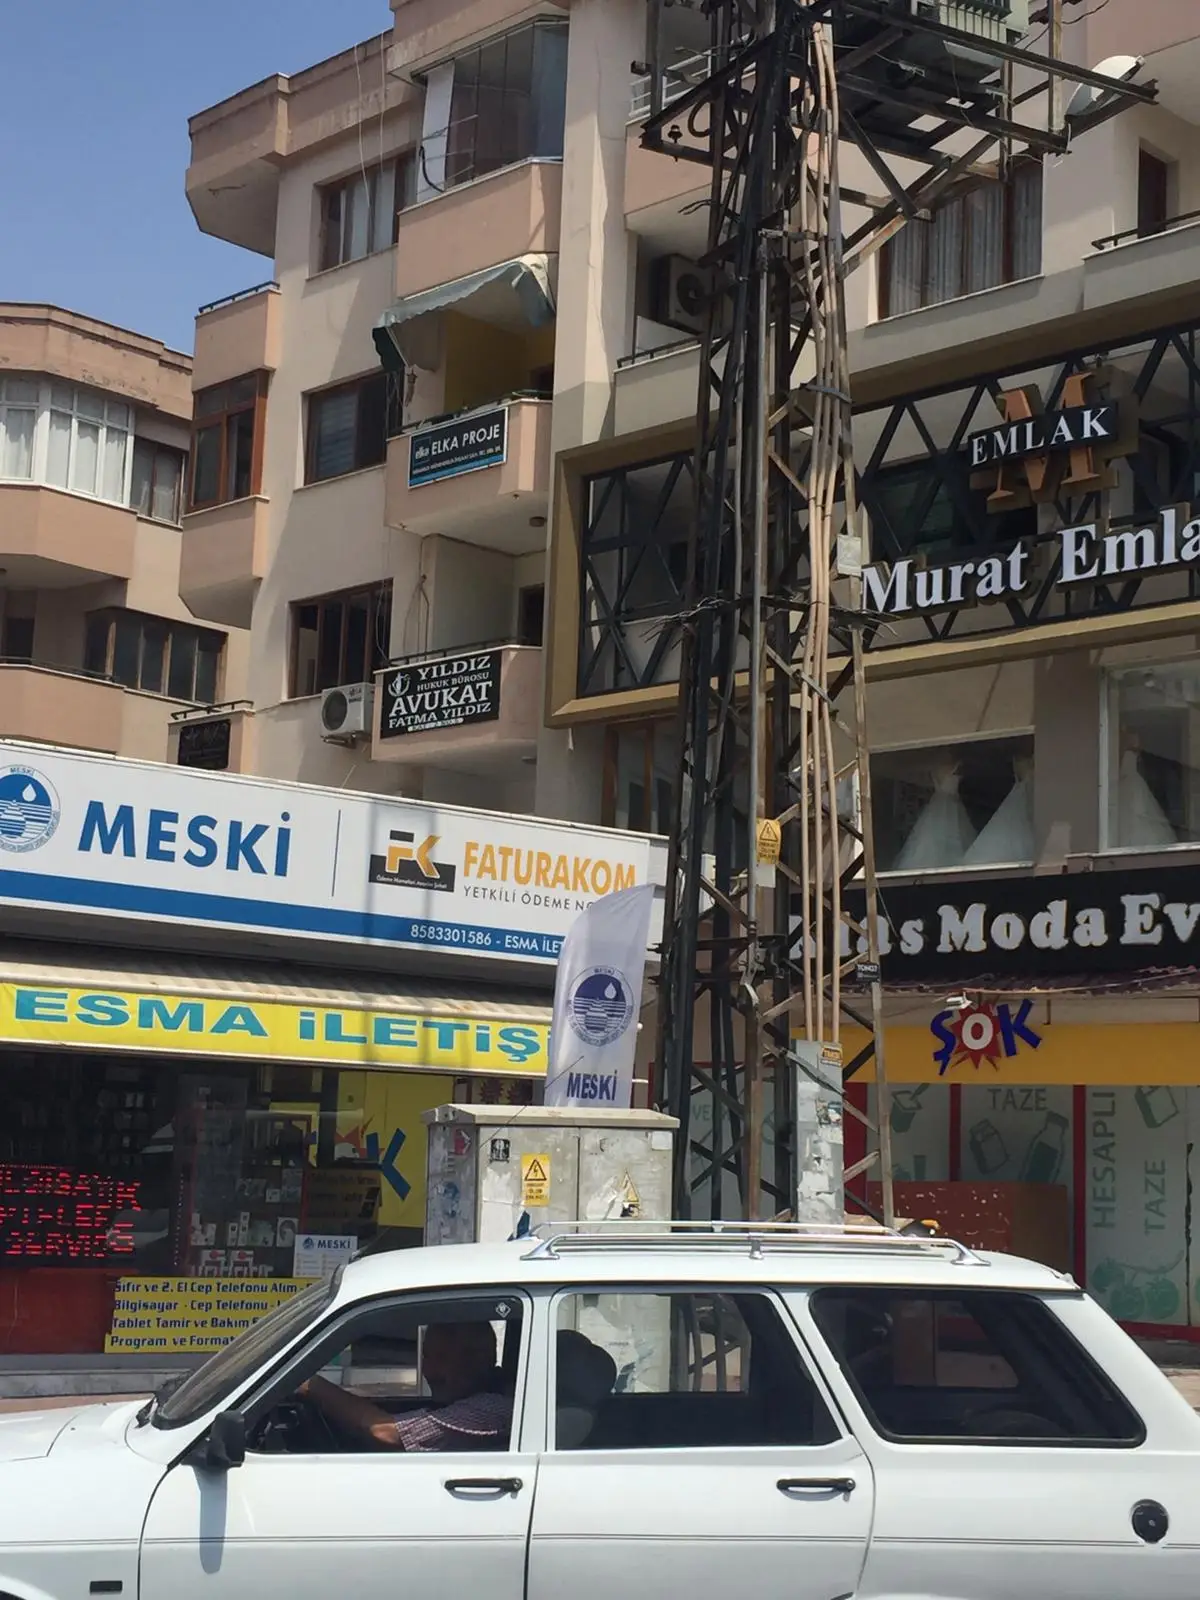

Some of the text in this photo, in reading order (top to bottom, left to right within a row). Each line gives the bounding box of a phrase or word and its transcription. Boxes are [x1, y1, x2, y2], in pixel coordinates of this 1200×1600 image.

[431, 423, 500, 456] ELKA PROJE
[971, 406, 1111, 467] EMLAK
[862, 542, 1028, 614] Murat
[417, 655, 491, 680] YILDIZ
[389, 680, 493, 717] AVUKAT
[416, 679, 449, 692] HUKUK
[388, 712, 437, 729] FATMA
[442, 702, 491, 719] YILDIZ
[78, 800, 291, 877] MESKİ
[463, 841, 636, 896] FATURAKOM
[463, 885, 516, 903] YETKİLİ
[521, 892, 570, 910] ÖDEME
[410, 924, 492, 946] 8583301586
[504, 935, 539, 951] ESMA
[937, 899, 1109, 953] Moda
[15, 988, 269, 1038] ESMA
[930, 998, 1043, 1076] ŞOK
[567, 1069, 618, 1101] MESKİ
[987, 1088, 1048, 1111] TAZE
[1092, 1091, 1116, 1229] HESAPLI
[1144, 1159, 1166, 1236] TAZE
[317, 1238, 351, 1249] MESKİ
[145, 1282, 158, 1292] ve
[177, 1281, 187, 1292] El
[191, 1281, 212, 1295] Cep
[216, 1281, 267, 1293] Telefonu
[271, 1283, 297, 1293] Alım
[115, 1300, 179, 1313] Bilgisayar
[191, 1300, 211, 1312] Cep
[216, 1300, 268, 1311] Telefonu
[113, 1318, 151, 1329] Tablet
[156, 1318, 190, 1329] Tamir
[194, 1320, 208, 1329] ve
[211, 1318, 249, 1330] Bakım
[111, 1336, 167, 1350] Program
[173, 1338, 187, 1347] ve
